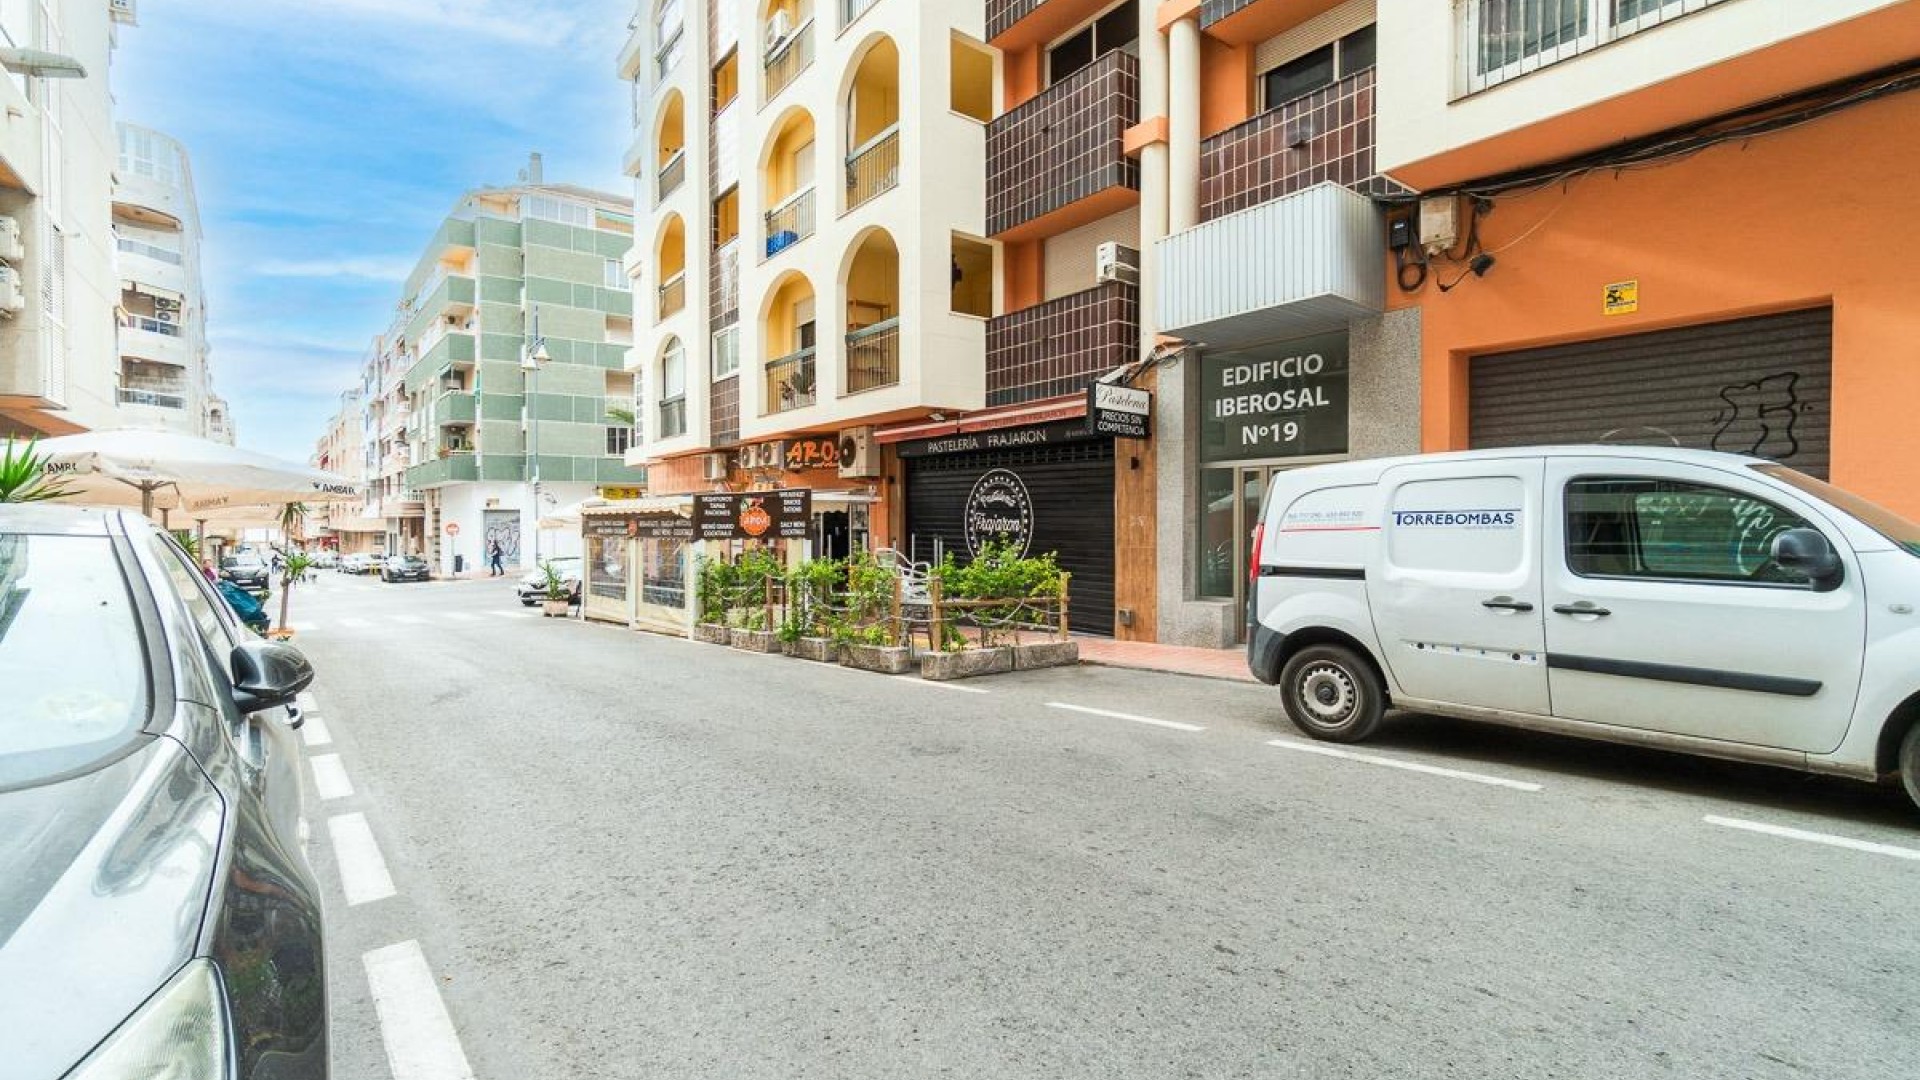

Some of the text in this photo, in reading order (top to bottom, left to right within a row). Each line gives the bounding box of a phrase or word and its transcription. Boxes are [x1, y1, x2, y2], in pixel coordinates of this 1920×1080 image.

[1222, 353, 1324, 387] EDIFICIO
[1215, 386, 1330, 418] IBEROSAL
[1101, 410, 1142, 426] PRECIOS SIN
[1097, 421, 1145, 436] COMPETENCIA
[927, 434, 979, 453] PASTELERÍA
[988, 430, 1047, 448] FRAJARON
[1392, 510, 1515, 526] TORREBOMBAS
